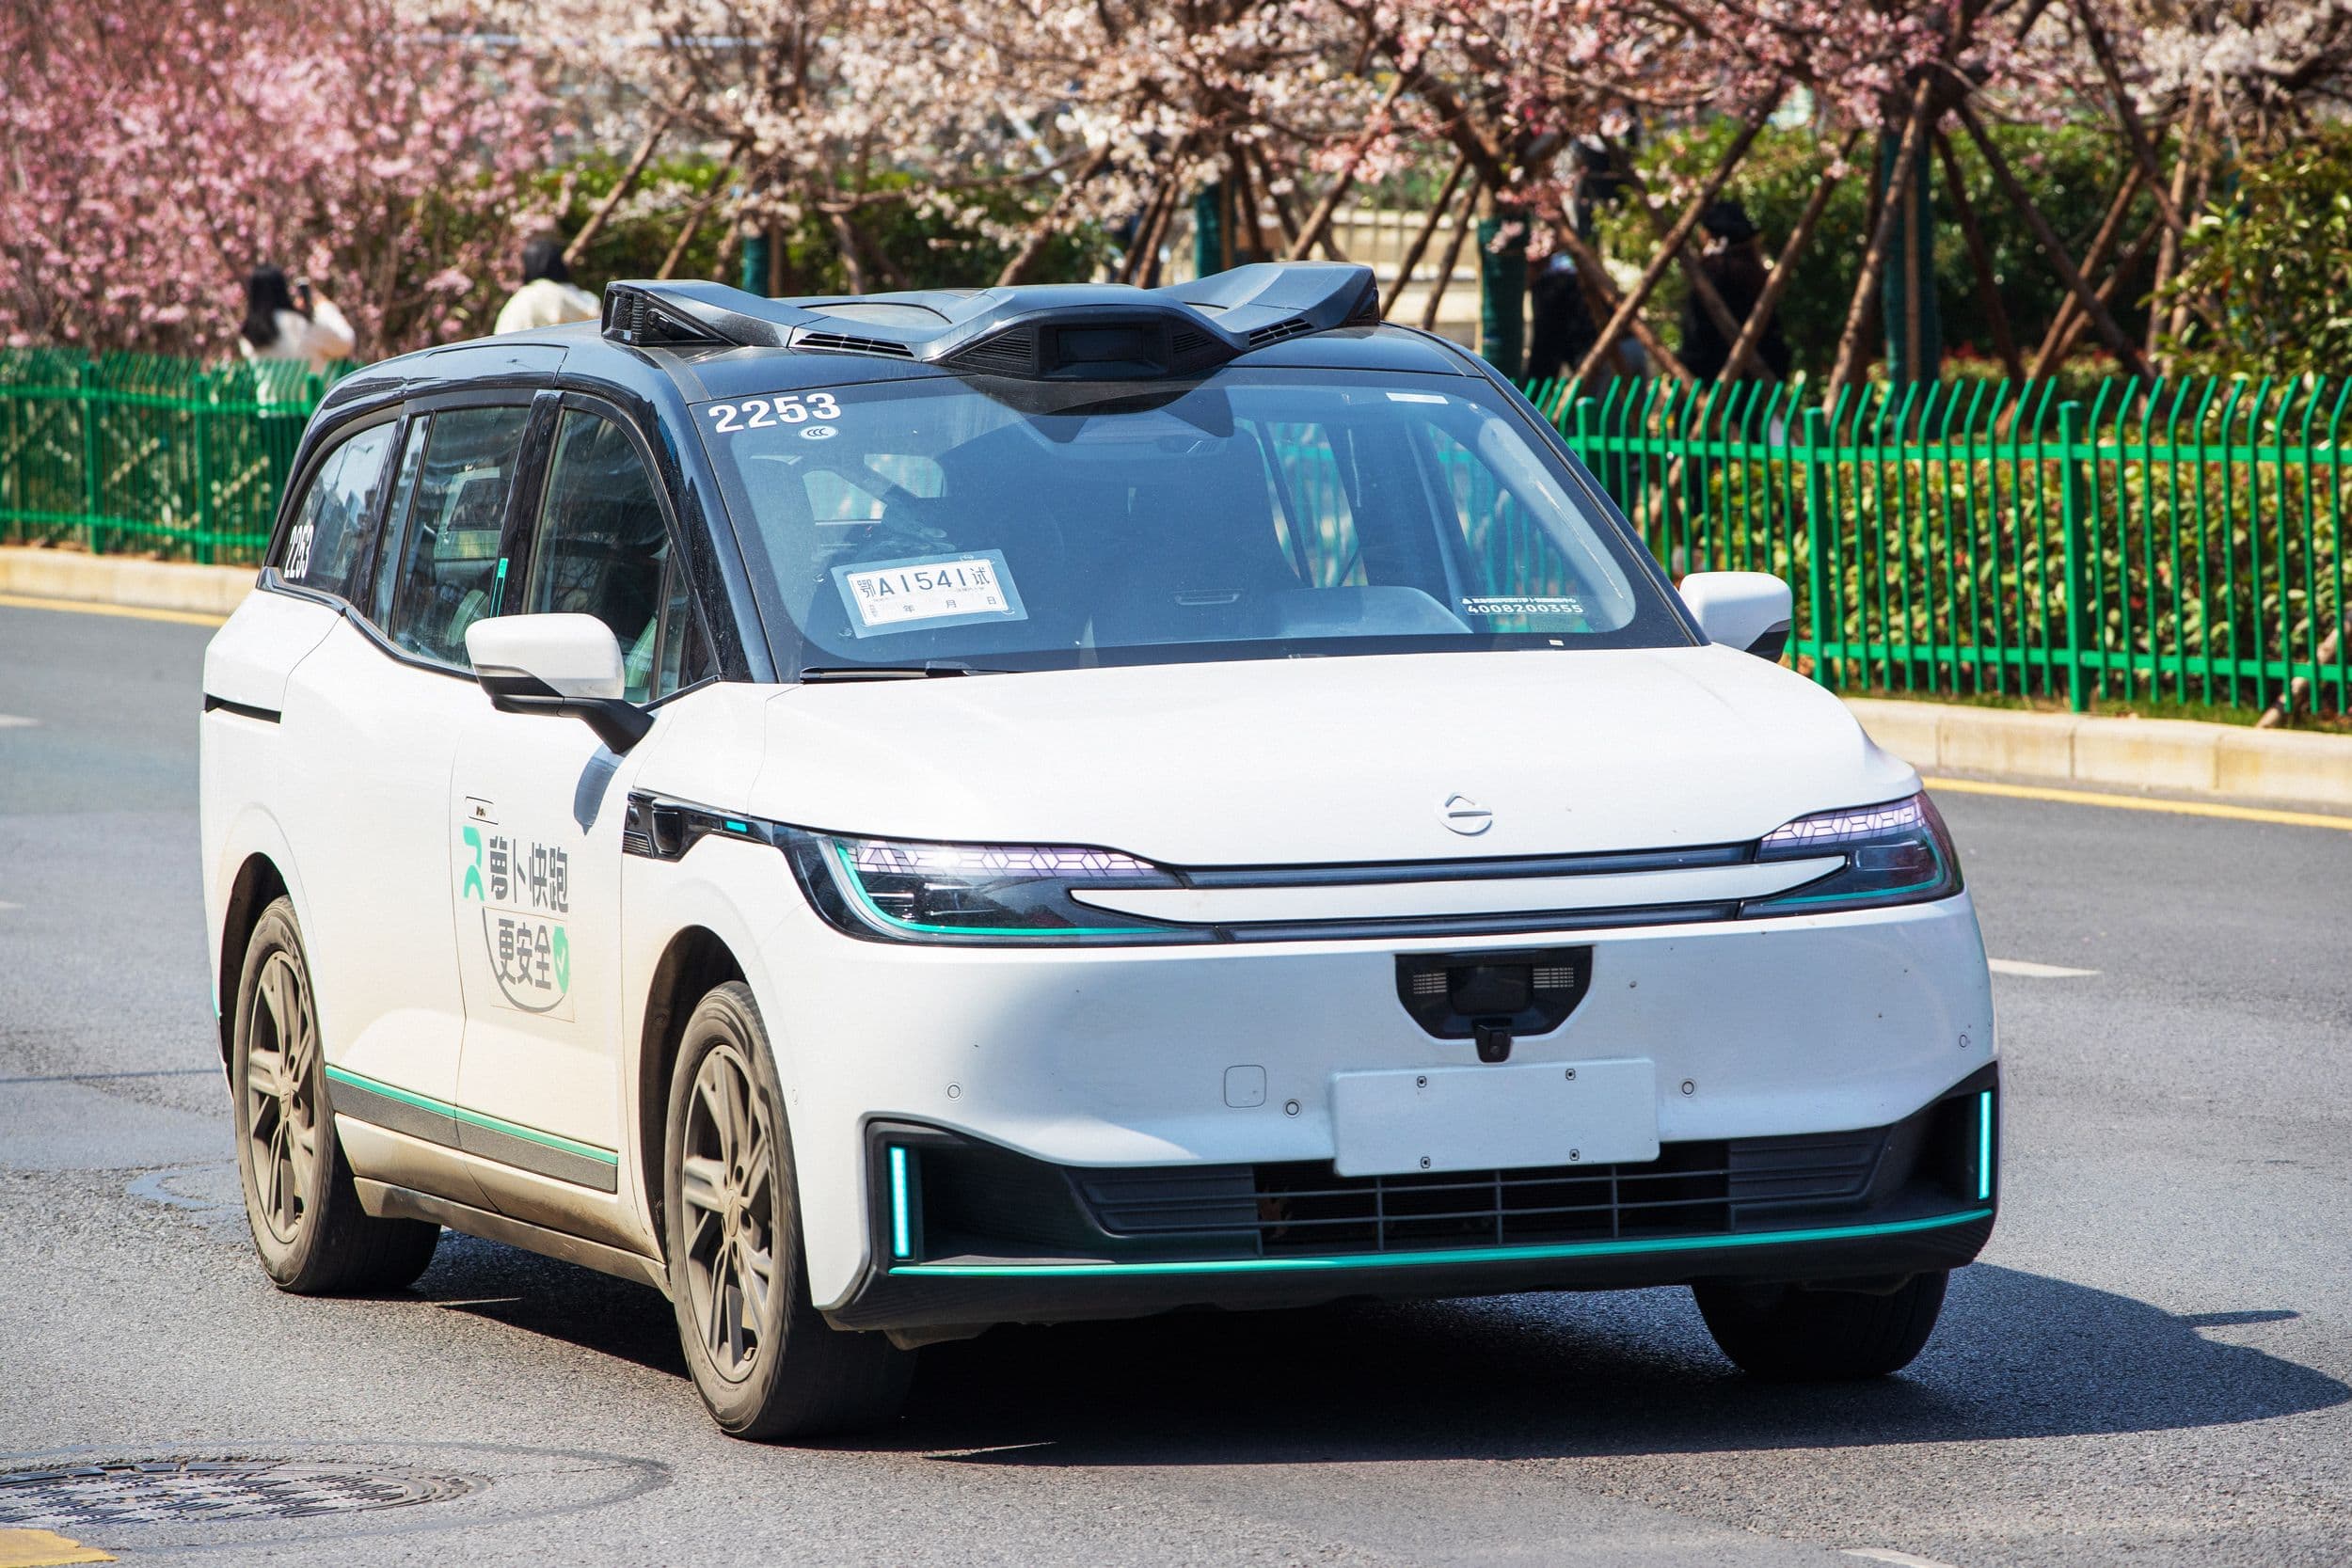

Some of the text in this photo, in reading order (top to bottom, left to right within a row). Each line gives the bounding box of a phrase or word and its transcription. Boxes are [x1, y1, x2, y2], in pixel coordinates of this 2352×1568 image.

[707, 392, 842, 434] 2253
[284, 525, 314, 579] 2253
[946, 599, 958, 609] 月
[988, 596, 997, 605] 日
[1468, 604, 1584, 613] 4008200355
[489, 835, 569, 913] 萝卜快跑
[499, 918, 552, 990] 更安全
